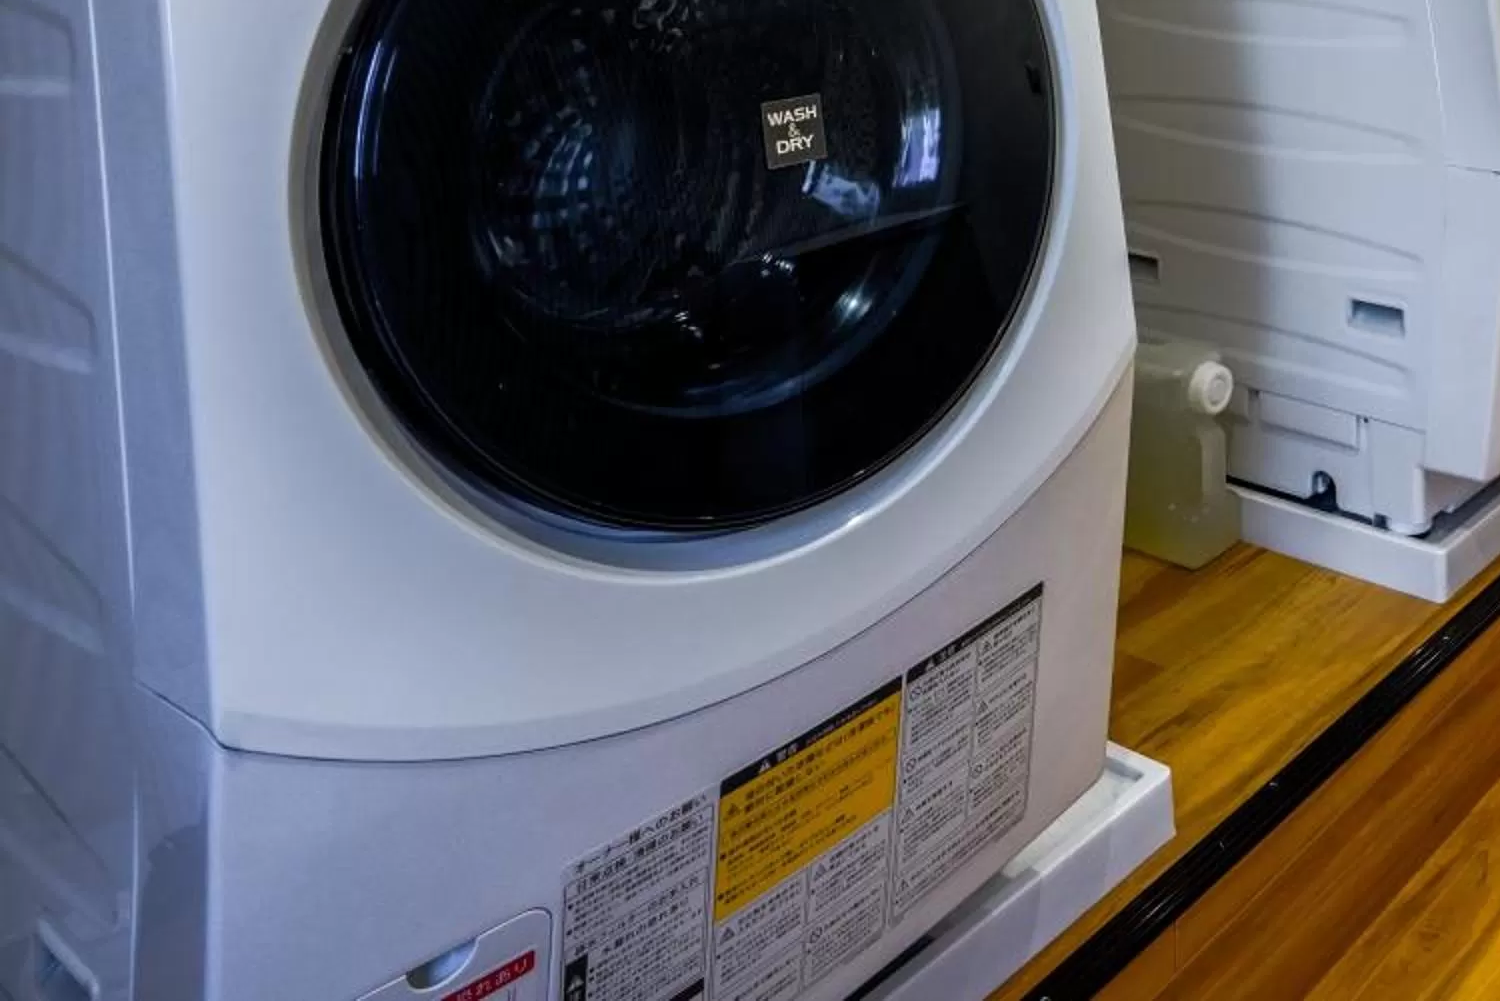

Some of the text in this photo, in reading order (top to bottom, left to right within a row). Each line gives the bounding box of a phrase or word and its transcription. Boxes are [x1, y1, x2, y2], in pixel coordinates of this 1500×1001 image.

[767, 104, 818, 127] WASH
[787, 125, 801, 138] &
[776, 134, 815, 155] DRY
